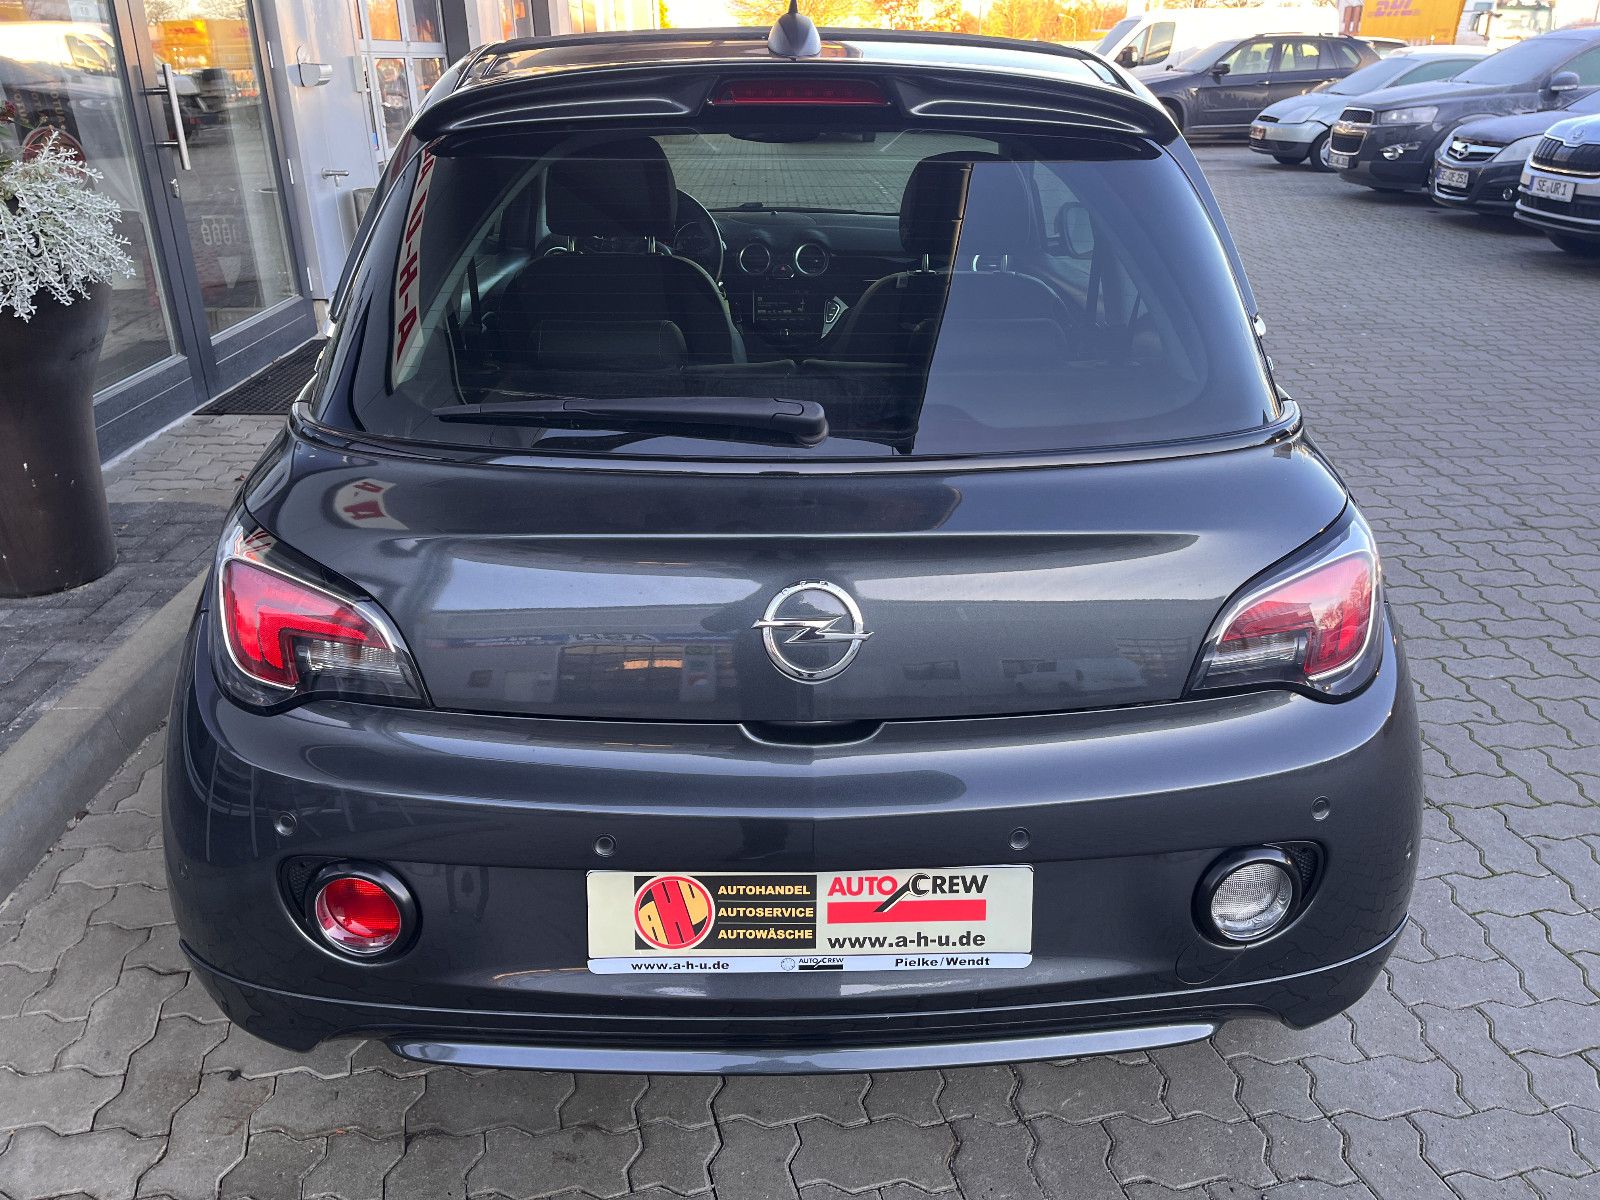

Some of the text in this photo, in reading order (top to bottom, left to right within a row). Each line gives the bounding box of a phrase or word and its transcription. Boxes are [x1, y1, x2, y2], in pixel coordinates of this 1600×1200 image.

[1536, 179, 1547, 192] SE
[717, 884, 811, 896] AUTOHANDEL
[827, 872, 988, 897] AUTO CREW
[717, 907, 814, 918] AUTOSERVICE
[717, 927, 813, 939] AUTOWÄSCHE
[827, 930, 987, 949] www.a-h-u.de
[631, 960, 730, 971] www.a-h-u.de
[821, 956, 845, 964] CREW
[894, 956, 991, 968] Pielke/Wendt
